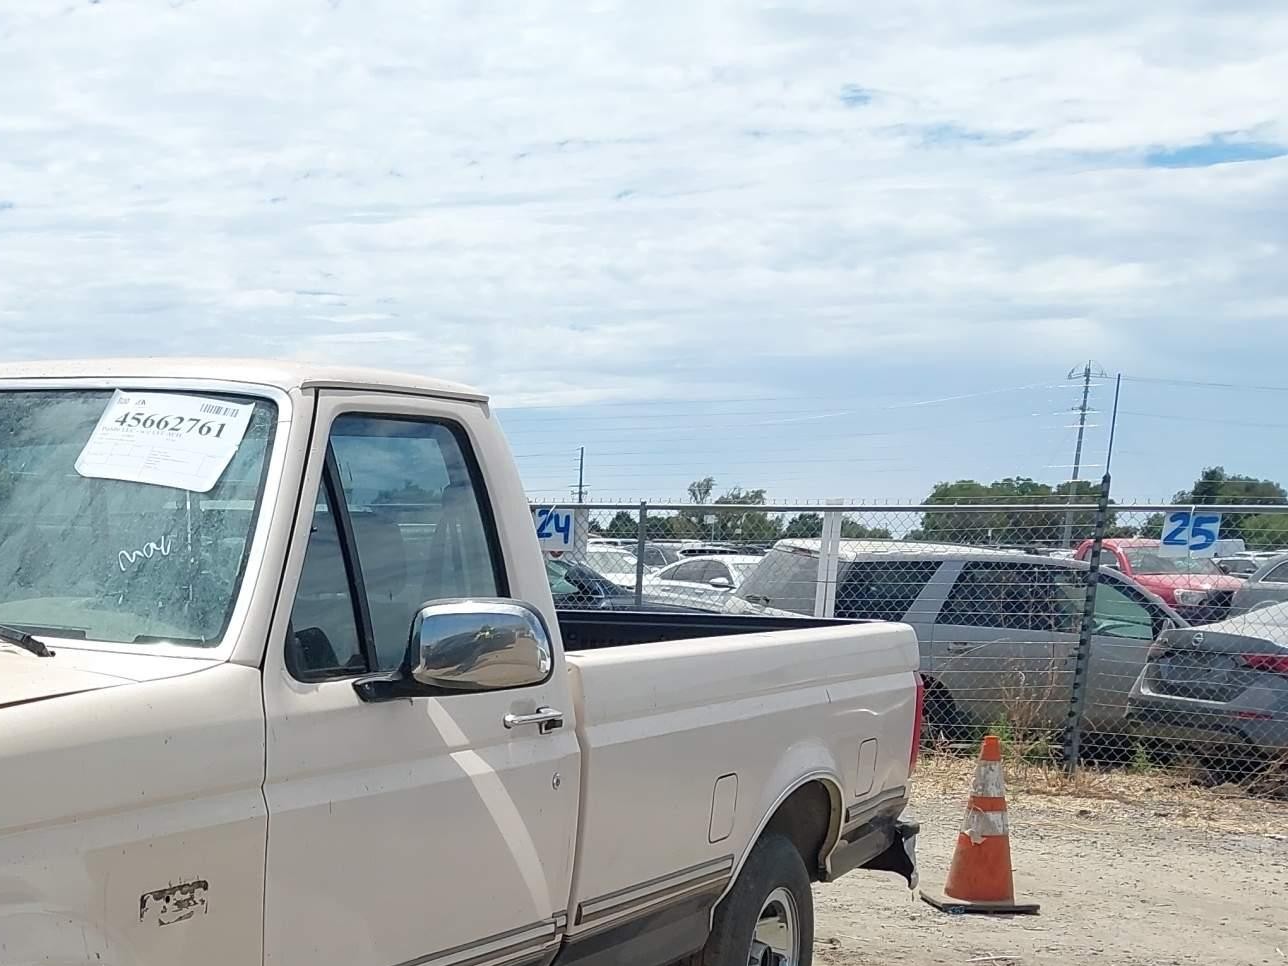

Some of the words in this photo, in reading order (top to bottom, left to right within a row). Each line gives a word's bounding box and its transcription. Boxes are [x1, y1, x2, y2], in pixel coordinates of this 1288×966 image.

[114, 411, 226, 438] 45662761
[537, 509, 570, 545] 24
[1162, 512, 1219, 550] 25
